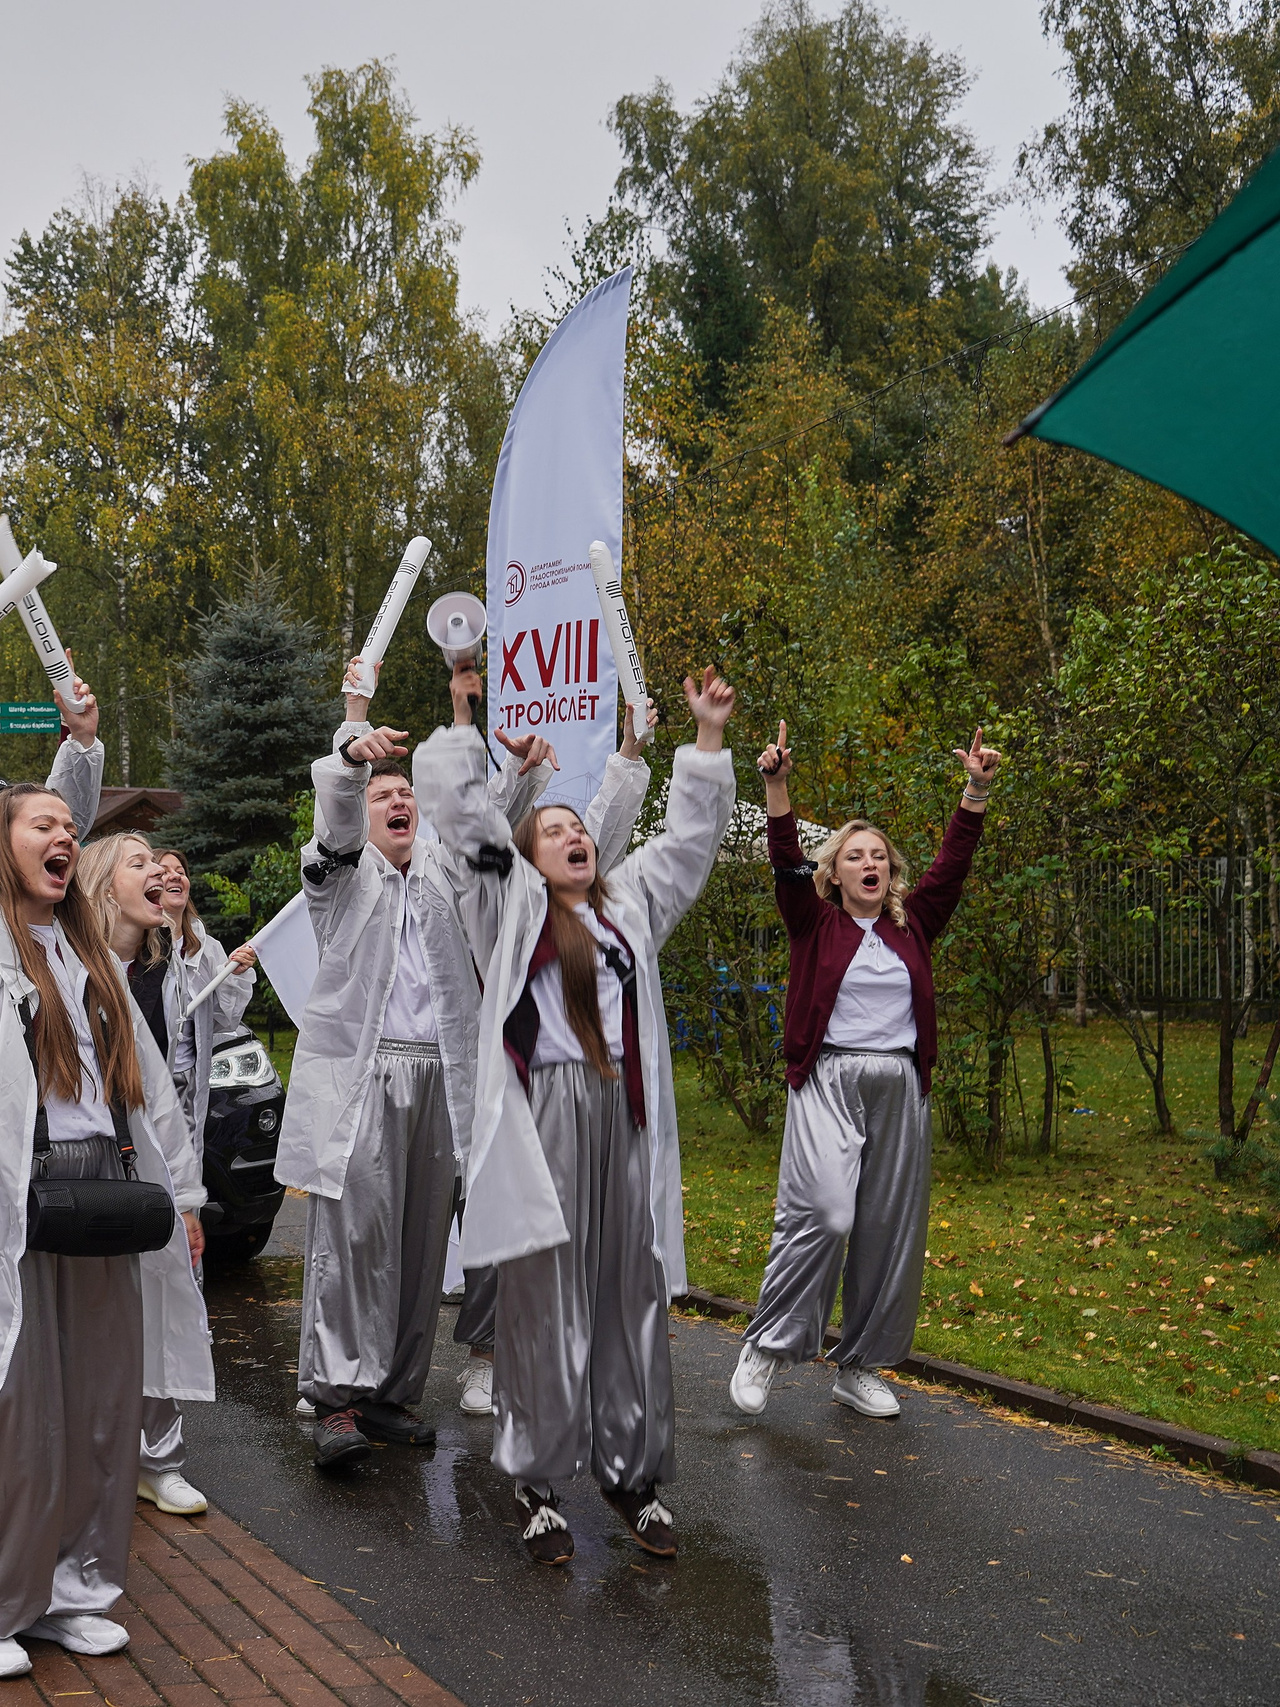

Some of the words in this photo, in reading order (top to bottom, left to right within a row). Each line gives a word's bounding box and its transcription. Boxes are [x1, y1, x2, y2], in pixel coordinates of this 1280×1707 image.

[529, 563, 576, 583] ГРАДОСТРОИТЕЛЬНОЙ
[575, 562, 592, 572] ПОЛИТ
[530, 558, 563, 574] ДЕПАРТАМЕНТ
[529, 580, 551, 591] ГОРОДА
[550, 576, 569, 586] МОСКВЫ
[500, 618, 600, 696] XVIII
[616, 608, 646, 695] PIONEER
